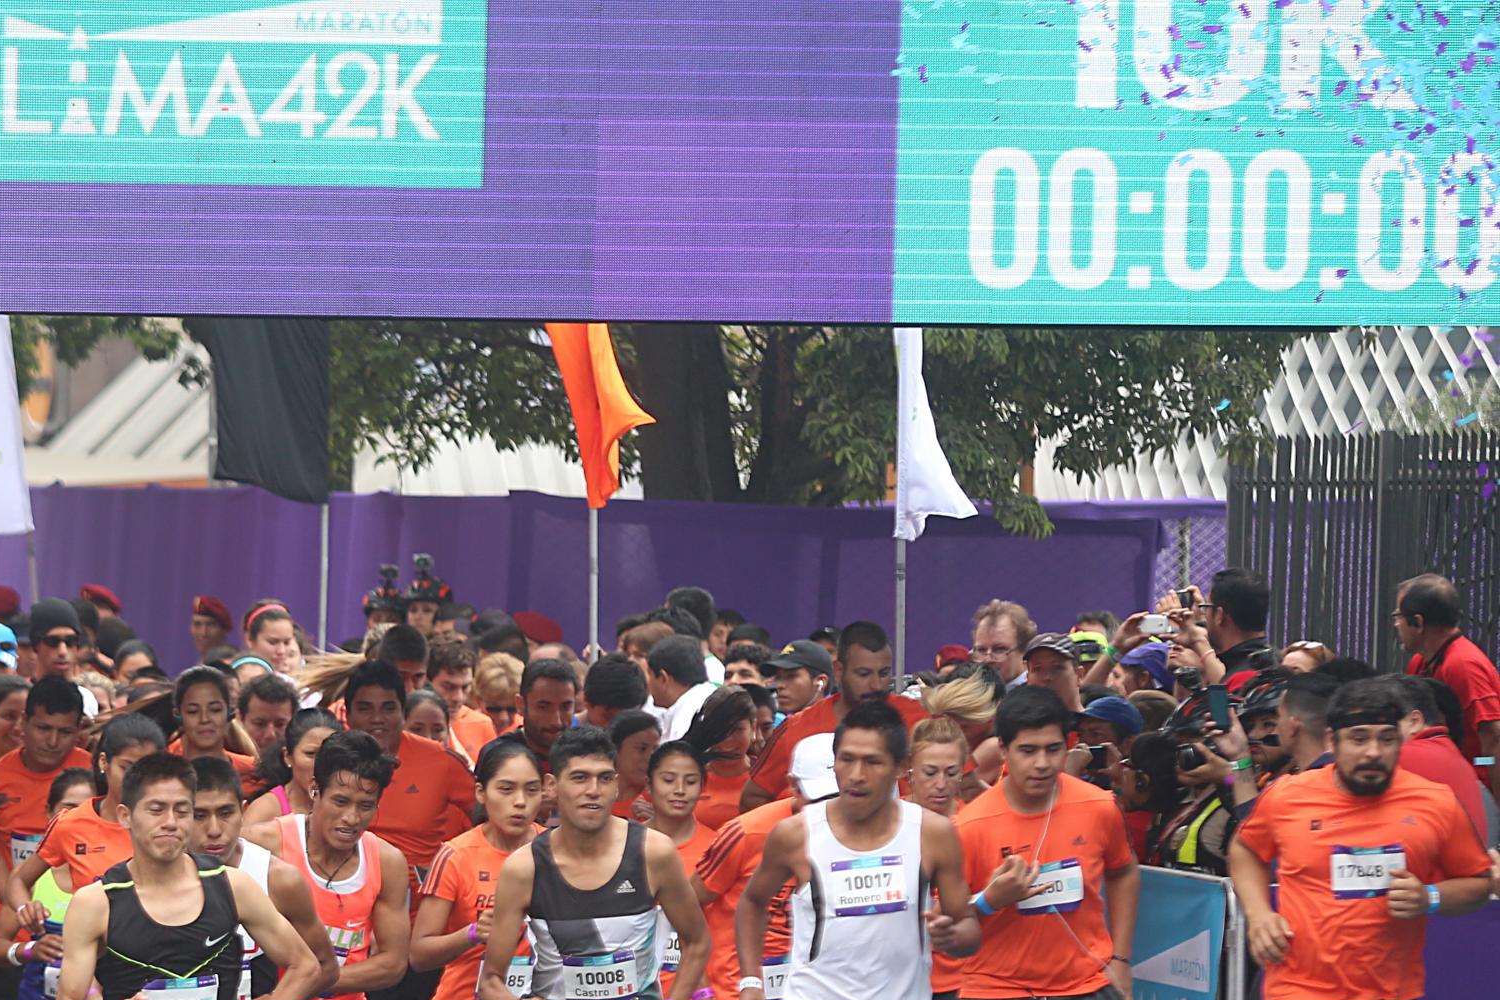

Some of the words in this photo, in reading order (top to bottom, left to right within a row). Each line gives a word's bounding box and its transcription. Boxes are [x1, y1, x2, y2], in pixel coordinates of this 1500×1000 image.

[294, 10, 436, 33] MARATÓN
[845, 872, 892, 891] 10017
[840, 894, 881, 905] Romero
[576, 969, 626, 986] 10008
[575, 987, 610, 997] Castro
